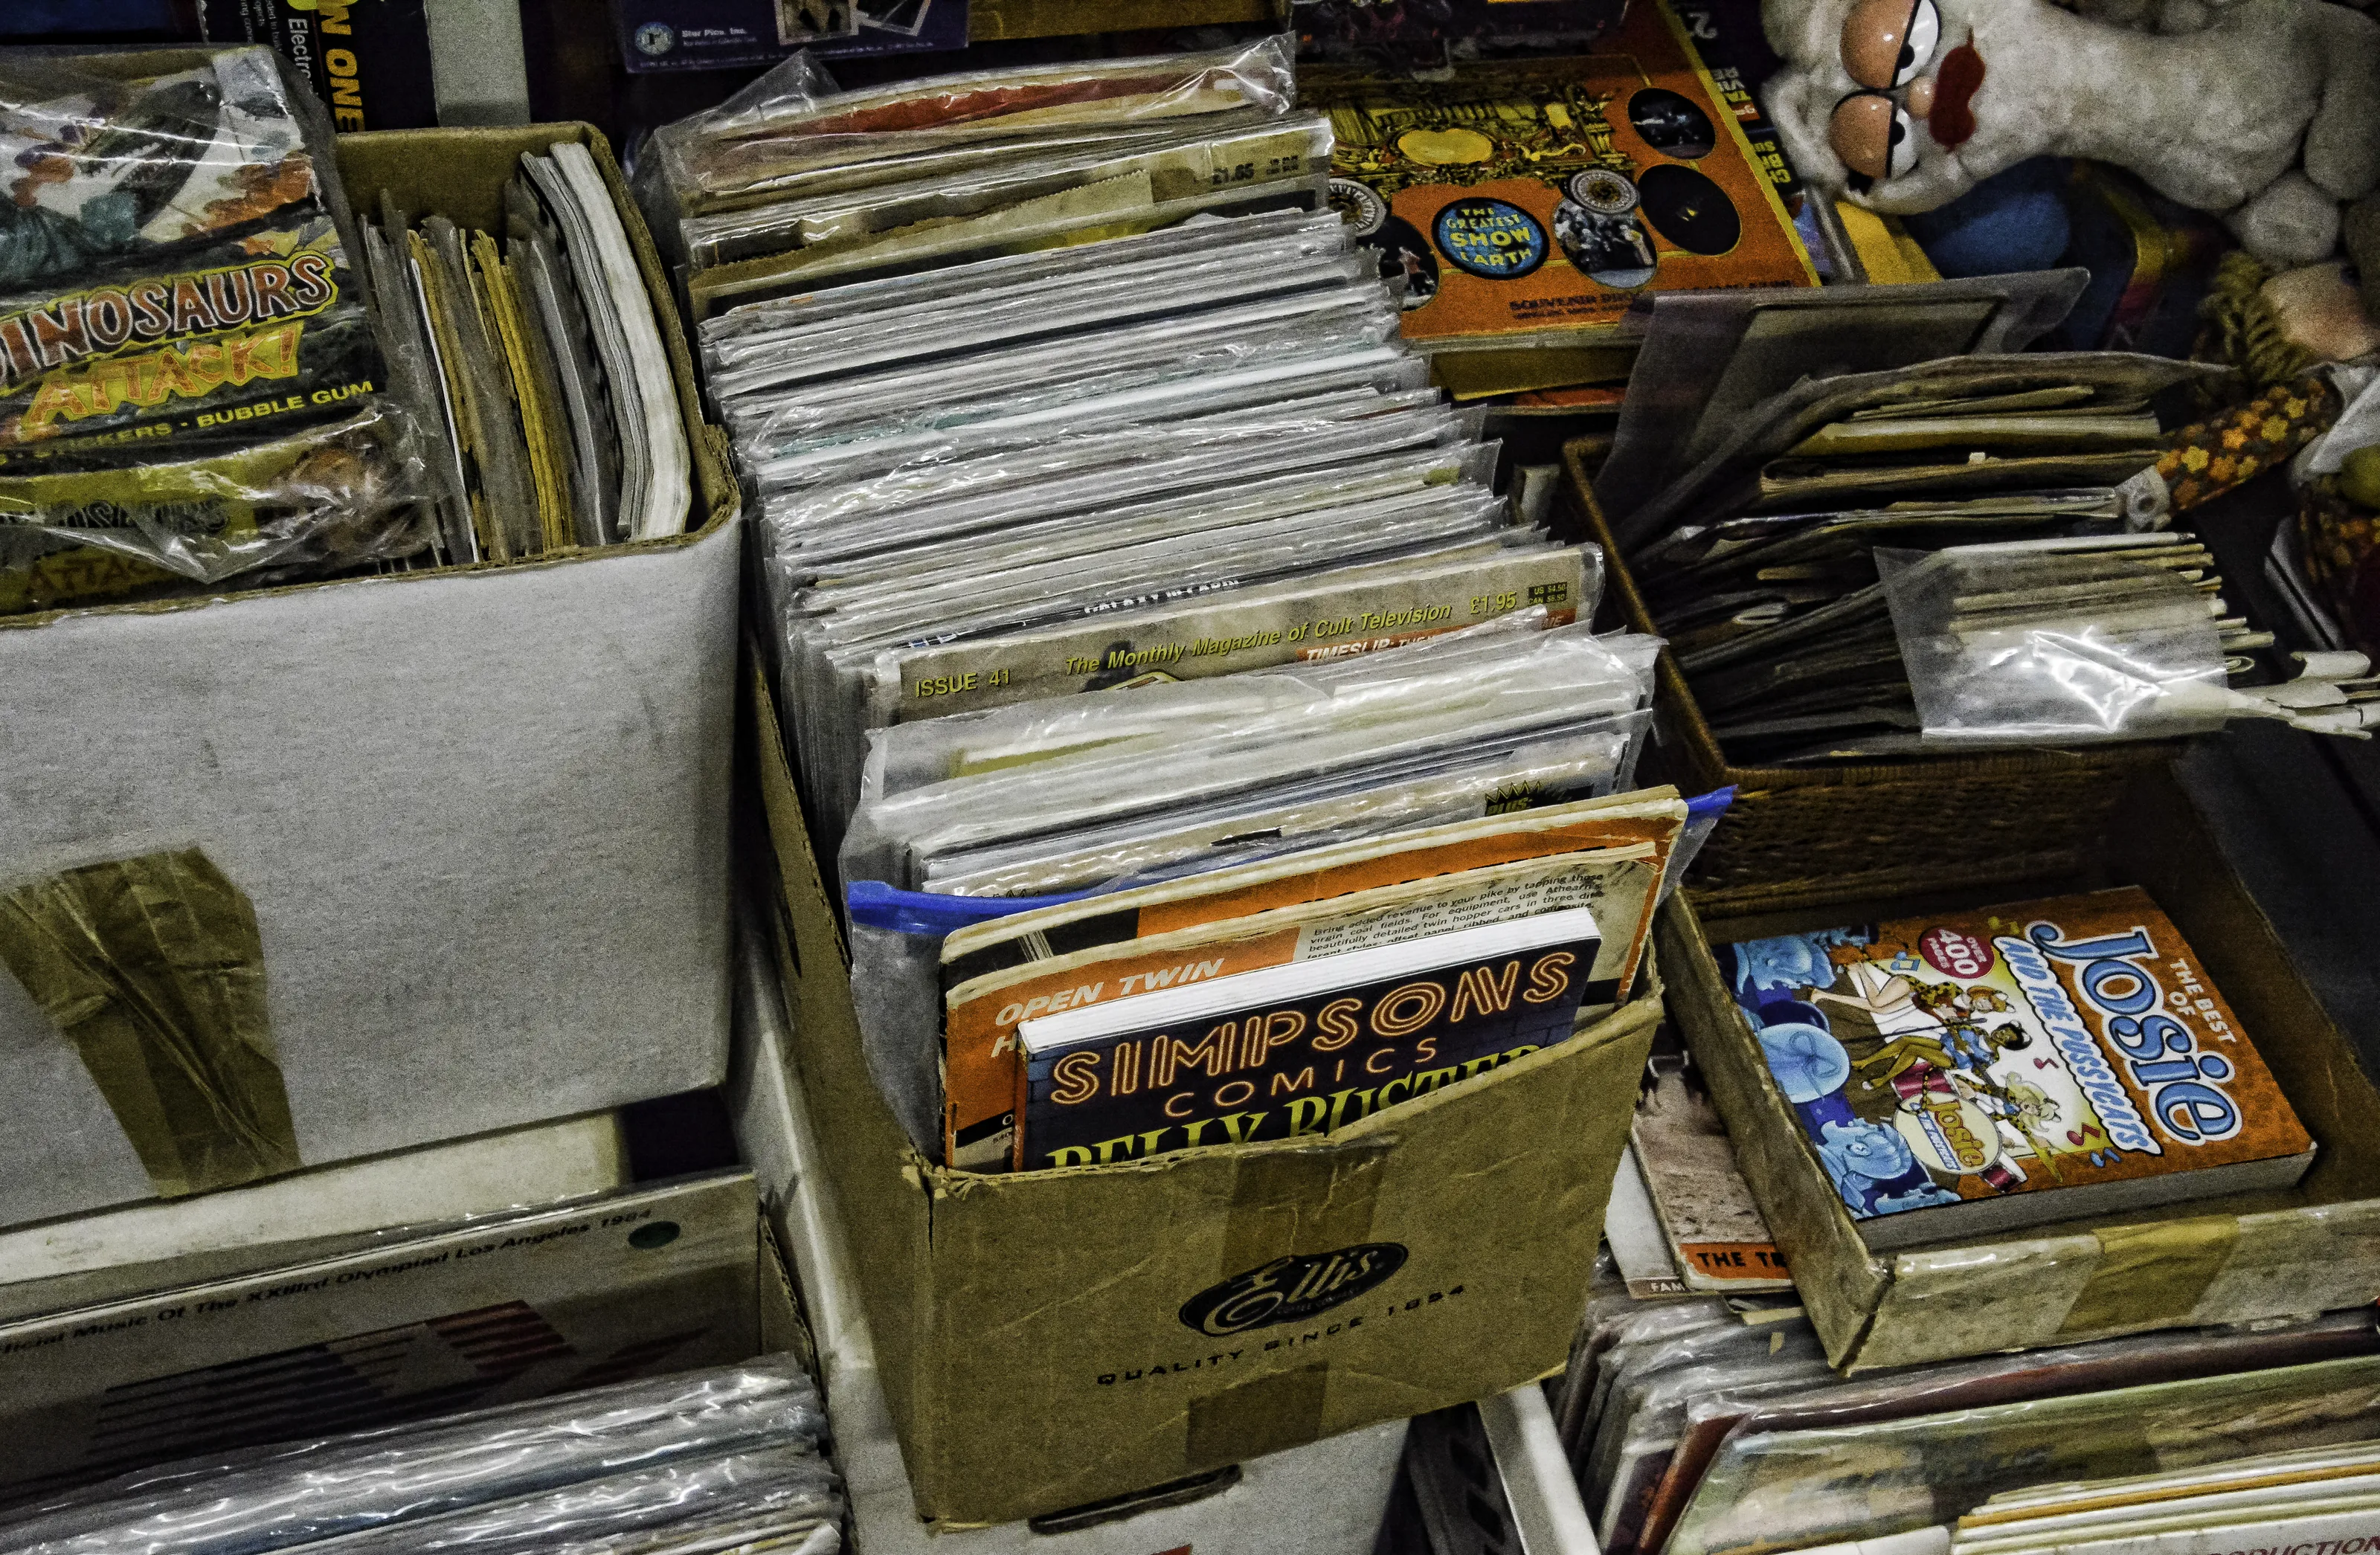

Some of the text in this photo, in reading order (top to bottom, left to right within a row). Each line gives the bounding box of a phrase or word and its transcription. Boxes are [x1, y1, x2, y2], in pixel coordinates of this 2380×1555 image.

[326, 48, 365, 132] ONE
[1446, 213, 1521, 229] GREATEST
[1450, 227, 1531, 248] SHOW
[1459, 248, 1532, 266] EARTH
[0, 255, 331, 379] INOSAURS
[28, 329, 295, 424] ATTACK!
[197, 396, 305, 429] BUBBLE
[312, 381, 374, 405] GUM
[916, 591, 1517, 698] ISSUE 41 The Monthly Magazine of Cult Television £1.95
[1308, 935, 1368, 953] beautifully
[1373, 923, 1419, 939] detailed
[1423, 918, 1447, 929] twin
[1453, 910, 1493, 923] hopper
[1497, 904, 1521, 913] cars
[1543, 895, 1575, 904] three
[1310, 933, 1343, 944] virgin
[1350, 925, 1373, 936] coal
[1421, 912, 1441, 921] For
[1519, 891, 1538, 900] use
[1313, 874, 1604, 936] Bring added revenue to your pike by tapping those
[1926, 938, 1950, 968] PAGES
[1938, 929, 1979, 974] 400
[1966, 936, 1987, 962] OVER
[995, 957, 1226, 1027] OPEN TWIN
[2169, 957, 2237, 1044] THE BEST
[2169, 991, 2197, 1017] OF
[1049, 951, 1577, 1106] SIMPSONS
[2000, 939, 2150, 1147] AND THE PUSSYCATS
[2027, 922, 2238, 1142] Josie
[1164, 1037, 1438, 1118] COMICS
[74, 1315, 148, 1340] Music
[196, 1296, 238, 1316] The
[335, 1251, 448, 1285] Olympiad
[454, 1241, 497, 1261] Los
[498, 1223, 591, 1250] Angeles
[599, 1208, 653, 1229] 1984
[1650, 1281, 1688, 1292] FAM
[1696, 1251, 1786, 1268] THE TR
[1202, 1251, 1379, 1336] Ellis
[1096, 1349, 1245, 1386] QUALITY
[1264, 1316, 1364, 1352] SINCE
